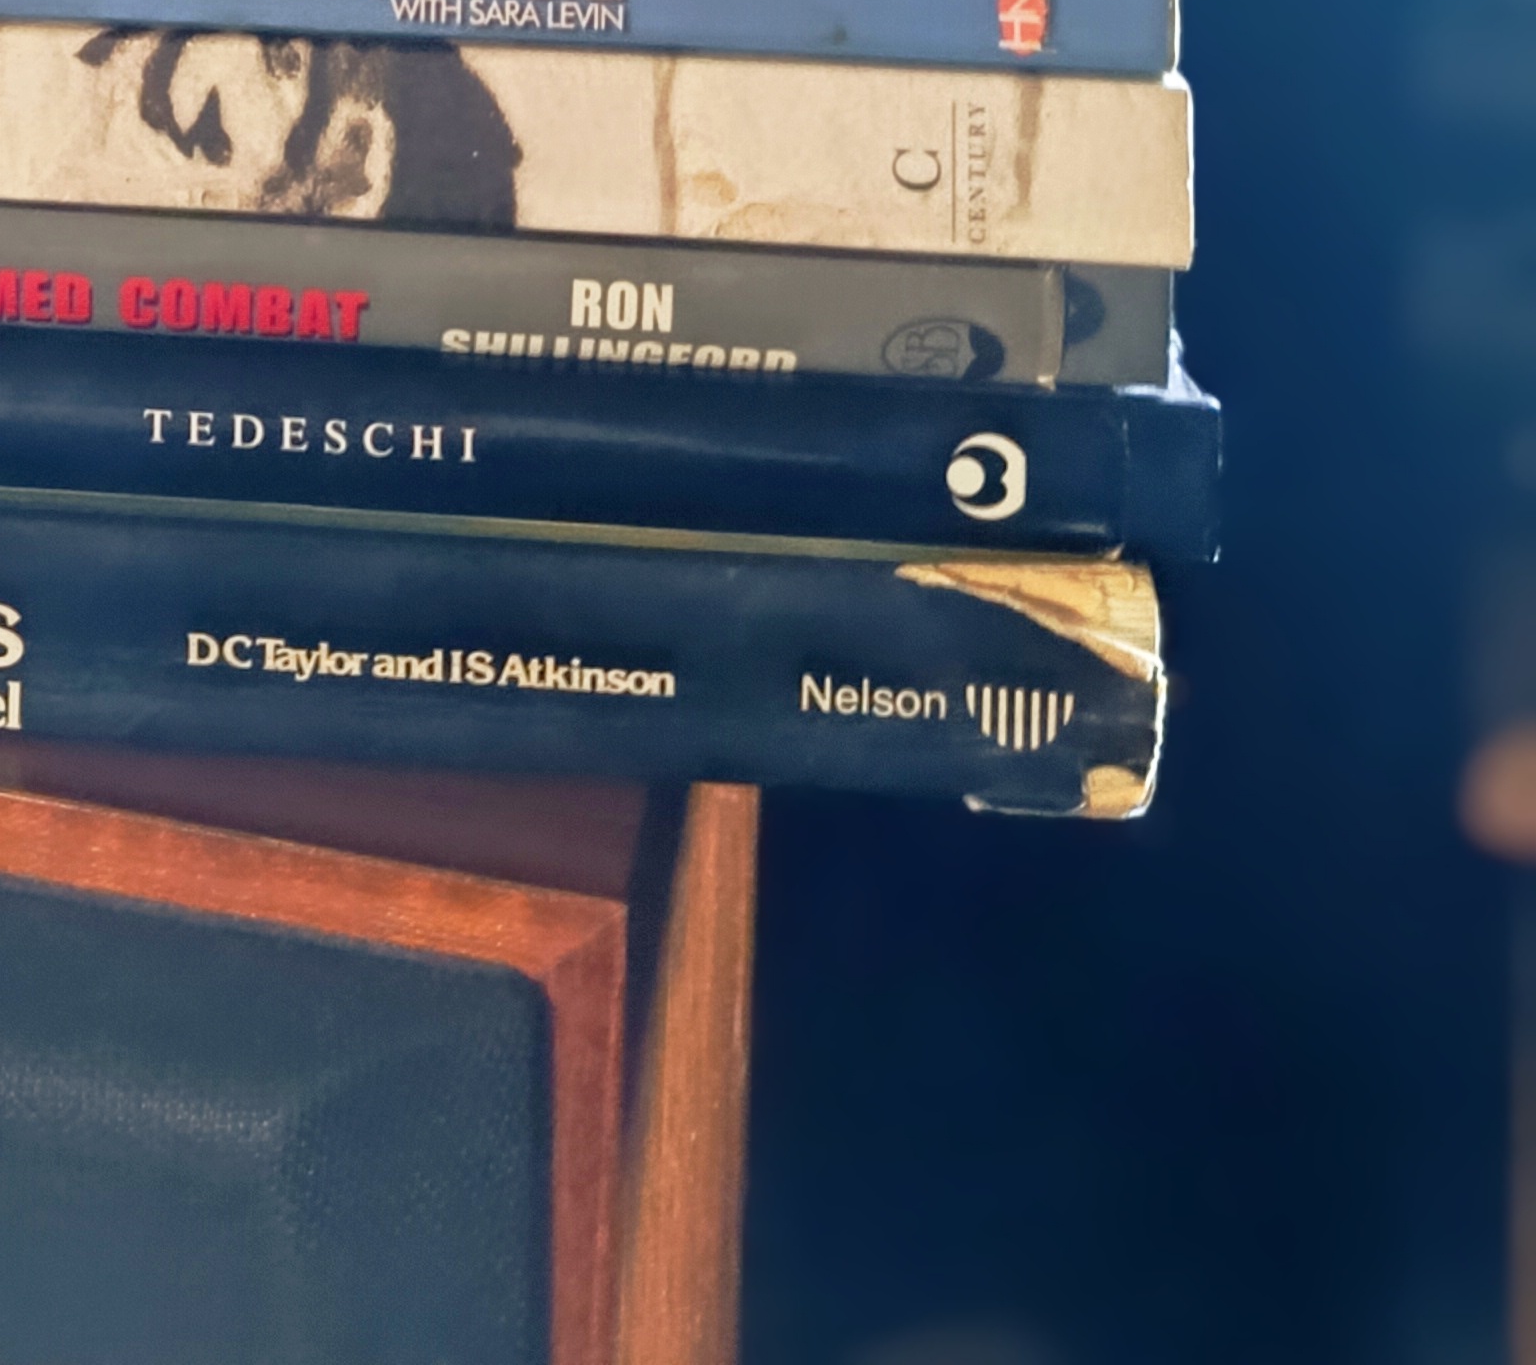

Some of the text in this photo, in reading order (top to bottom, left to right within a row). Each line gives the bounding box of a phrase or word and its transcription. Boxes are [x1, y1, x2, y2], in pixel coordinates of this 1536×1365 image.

[546, 1, 626, 34] LEVIN
[891, 146, 942, 193] C
[965, 101, 989, 247] CENTURY
[117, 275, 371, 342] COMBAT
[570, 277, 675, 334] RON
[144, 407, 478, 464] TEDESCHI
[256, 637, 368, 683] Taylor
[372, 648, 444, 683] and
[498, 653, 676, 698] Atkinson
[800, 672, 948, 722] Nelson
